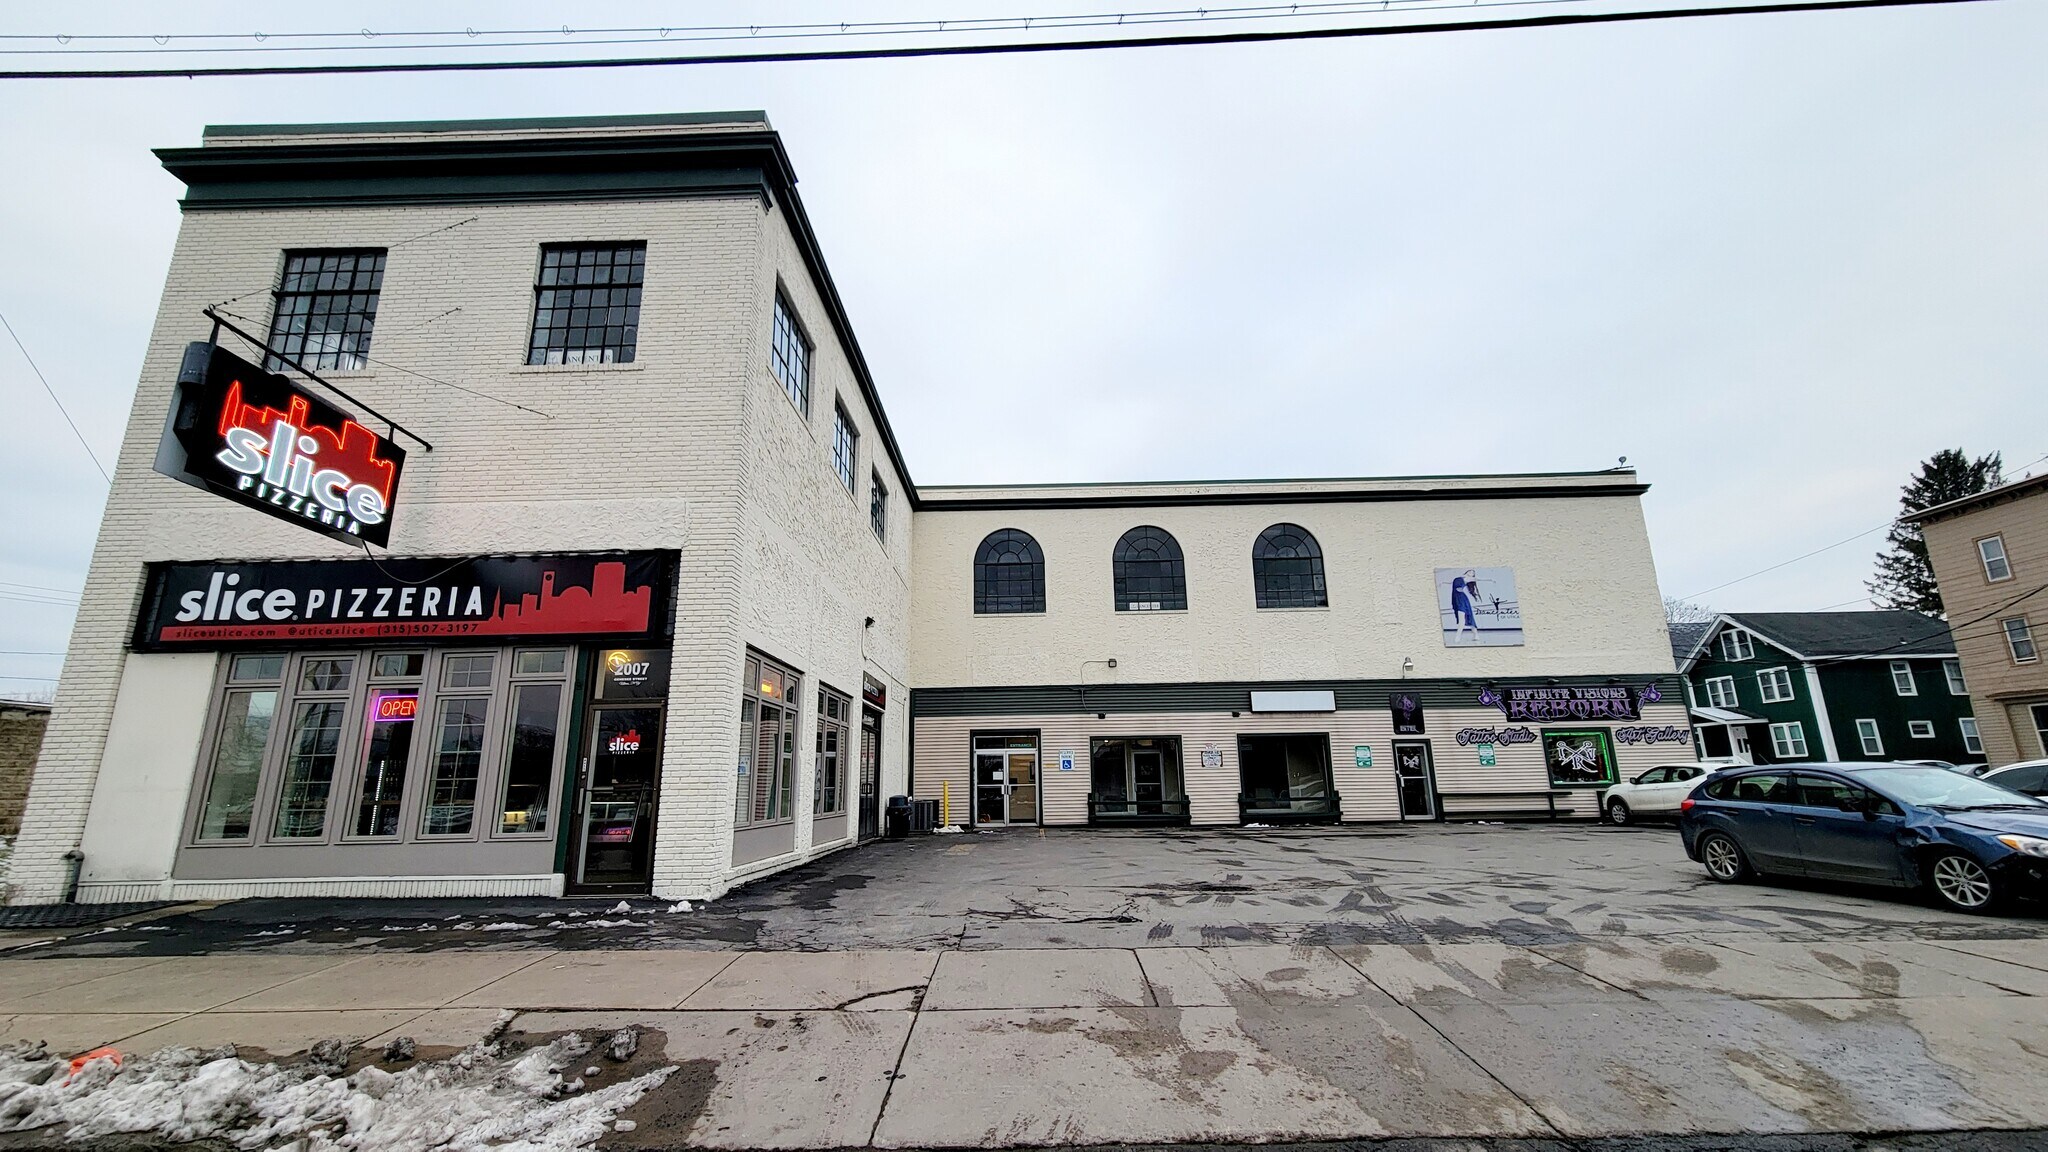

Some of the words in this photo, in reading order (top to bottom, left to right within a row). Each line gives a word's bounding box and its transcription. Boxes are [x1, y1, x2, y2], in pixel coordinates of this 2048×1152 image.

[215, 420, 384, 525] slice
[239, 474, 360, 536] PIZZERIA
[175, 572, 296, 622] slice
[305, 586, 483, 619] PIZZERIA
[176, 628, 276, 638] sliceutica.com
[287, 626, 365, 637] @uticaslice
[377, 623, 479, 636] (315)507-3197
[615, 662, 650, 676] 2007
[1511, 689, 1570, 700] INFINITE
[1571, 687, 1627, 699] VISIONS
[381, 700, 417, 717] OPEN
[1508, 699, 1638, 722] REBORN
[609, 737, 640, 751] slice
[1457, 727, 1498, 745] Tattoo
[1498, 727, 1536, 745] Studio
[1616, 727, 1645, 745] Art
[1645, 726, 1689, 745] Gallery
